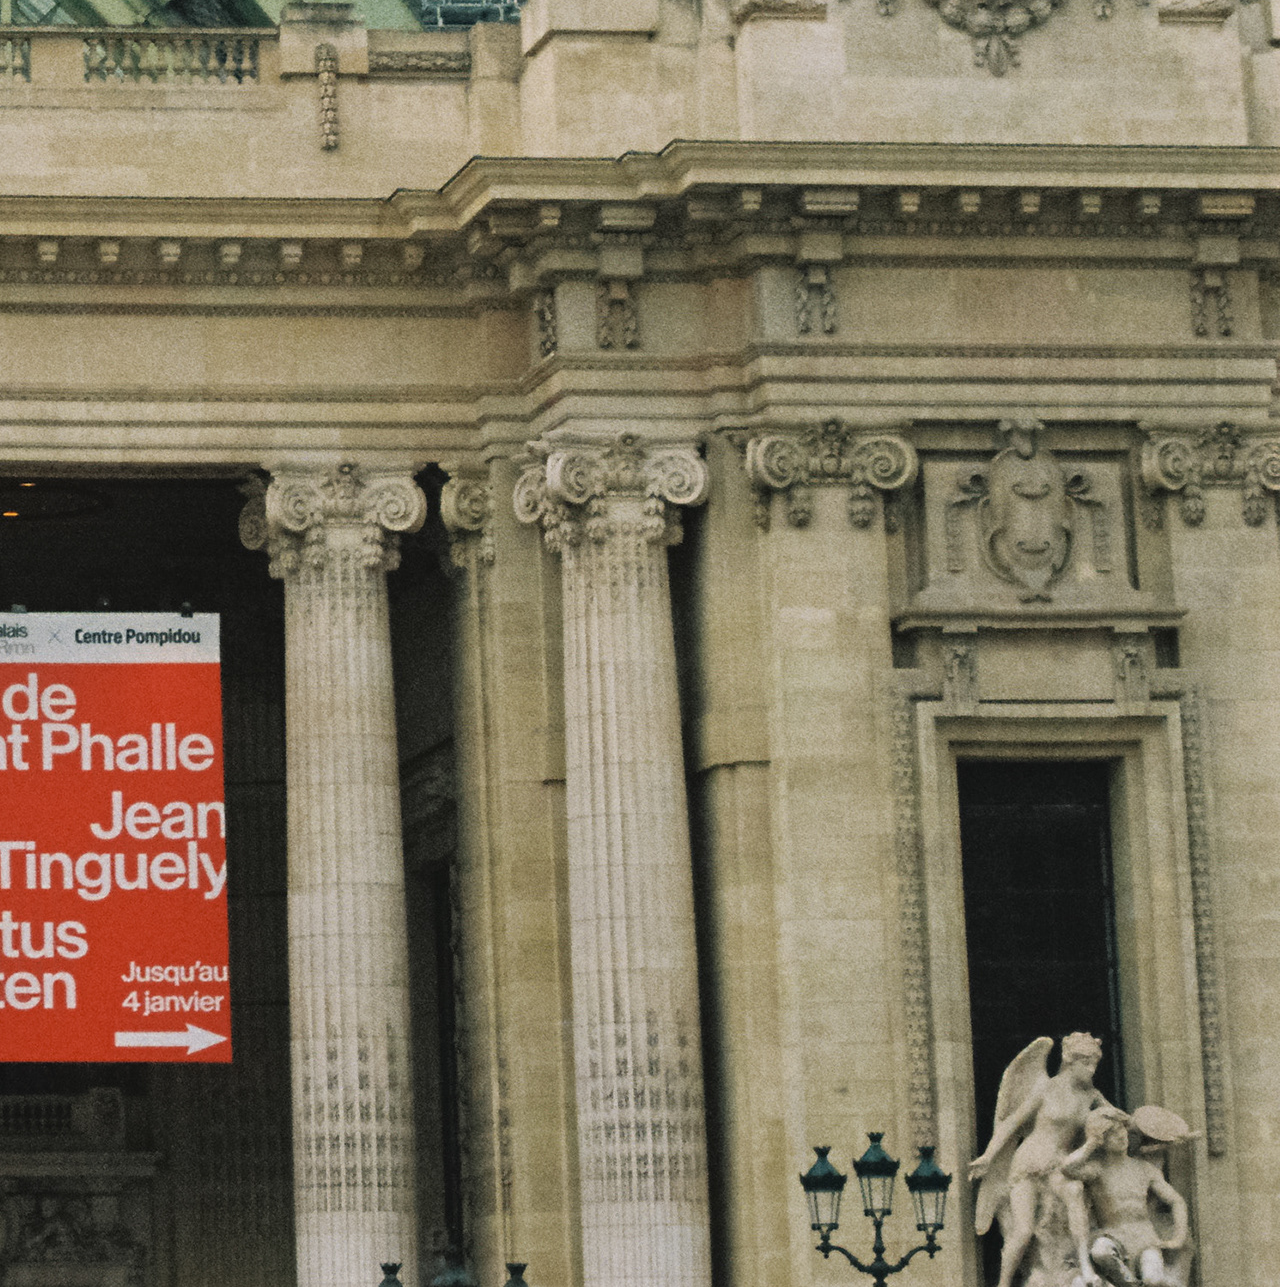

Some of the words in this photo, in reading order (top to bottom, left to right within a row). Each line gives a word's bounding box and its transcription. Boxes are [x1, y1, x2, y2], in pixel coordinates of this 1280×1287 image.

[75, 628, 123, 644] Centre
[126, 628, 201, 646] Pompidou
[2, 672, 77, 721] de
[42, 722, 214, 771] Phalle
[91, 790, 226, 840] Jean
[121, 960, 229, 986] Jusqu'au
[122, 991, 141, 1012] 4
[143, 990, 225, 1016] janvier
